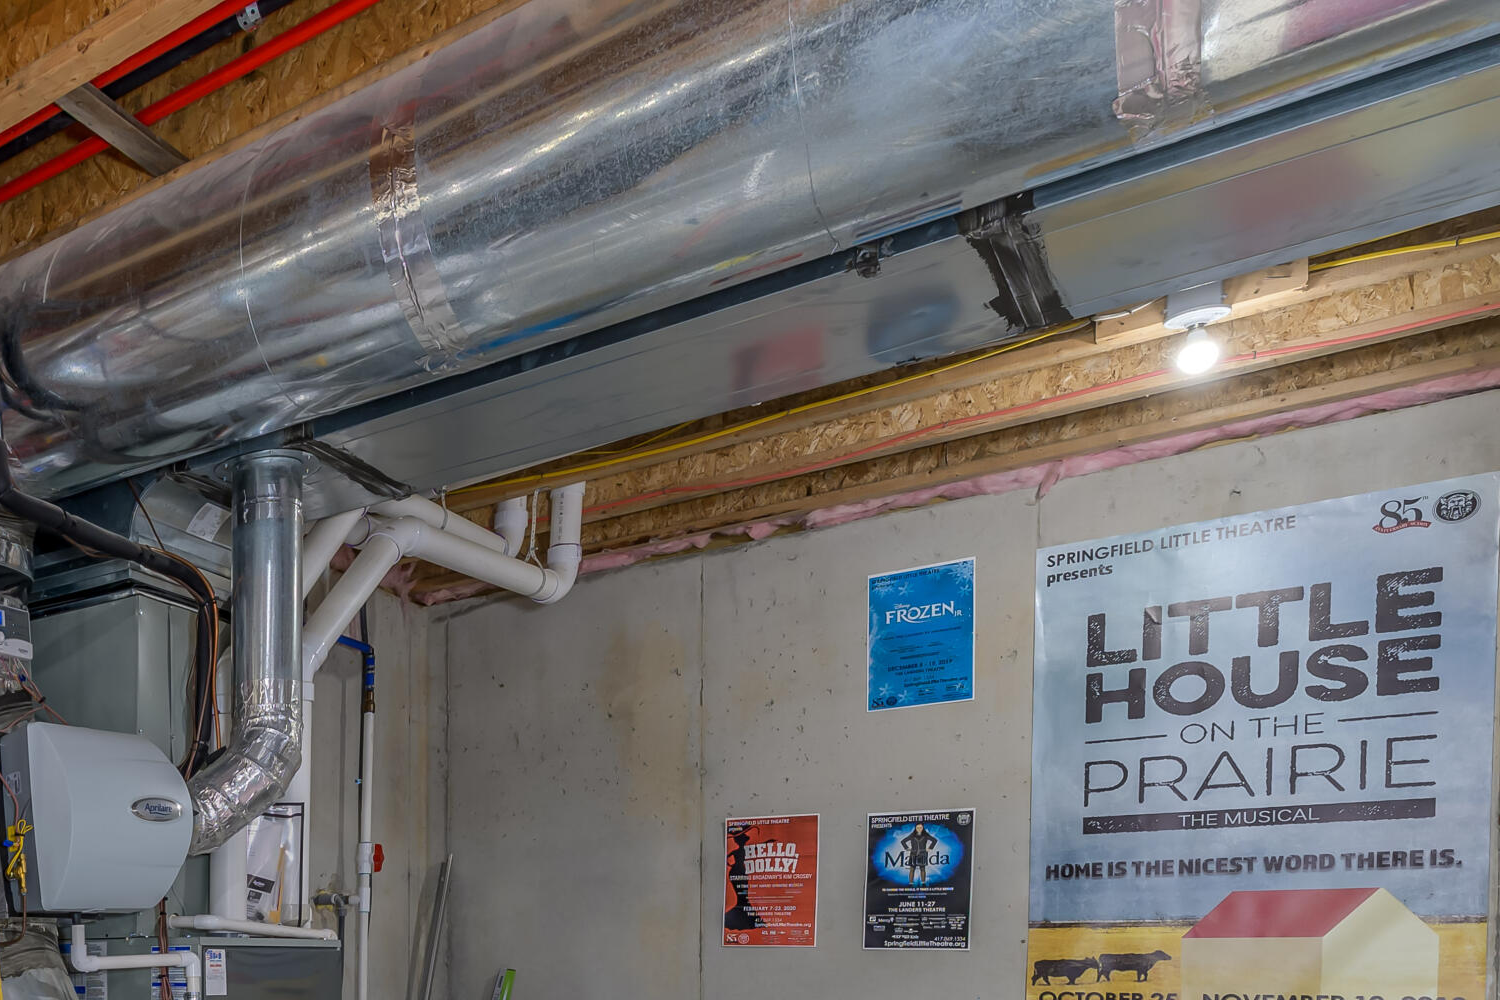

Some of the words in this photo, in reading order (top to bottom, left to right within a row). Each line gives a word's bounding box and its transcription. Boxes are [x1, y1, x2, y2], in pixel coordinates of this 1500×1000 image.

[1046, 539, 1154, 568] SPRINGFIELD
[1160, 530, 1211, 551] LITTLE
[1216, 515, 1296, 540] THEATRE
[1046, 562, 1113, 587] presents
[885, 600, 954, 625] FROZEN
[1086, 566, 1444, 668] LITTLE
[1085, 634, 1442, 724] HOUSE
[1179, 720, 1235, 744] ON
[1249, 712, 1325, 739] THE
[1084, 734, 1438, 807] PRAIRIE
[145, 802, 173, 814] Aprilaire
[871, 816, 908, 824] SPRINGFIELD
[923, 813, 950, 821] THEATRE
[1178, 813, 1220, 828] THE
[1224, 807, 1320, 826] MUSICAL
[744, 842, 799, 859] HELLO,
[744, 858, 798, 874] DOLLY!
[1045, 862, 1105, 882] HOME
[1107, 861, 1127, 879] IS
[1131, 859, 1174, 878] THE
[1178, 856, 1255, 877] NICEST
[1263, 853, 1335, 875] WORD
[1341, 850, 1425, 871] THERE
[1430, 848, 1463, 868] IS.
